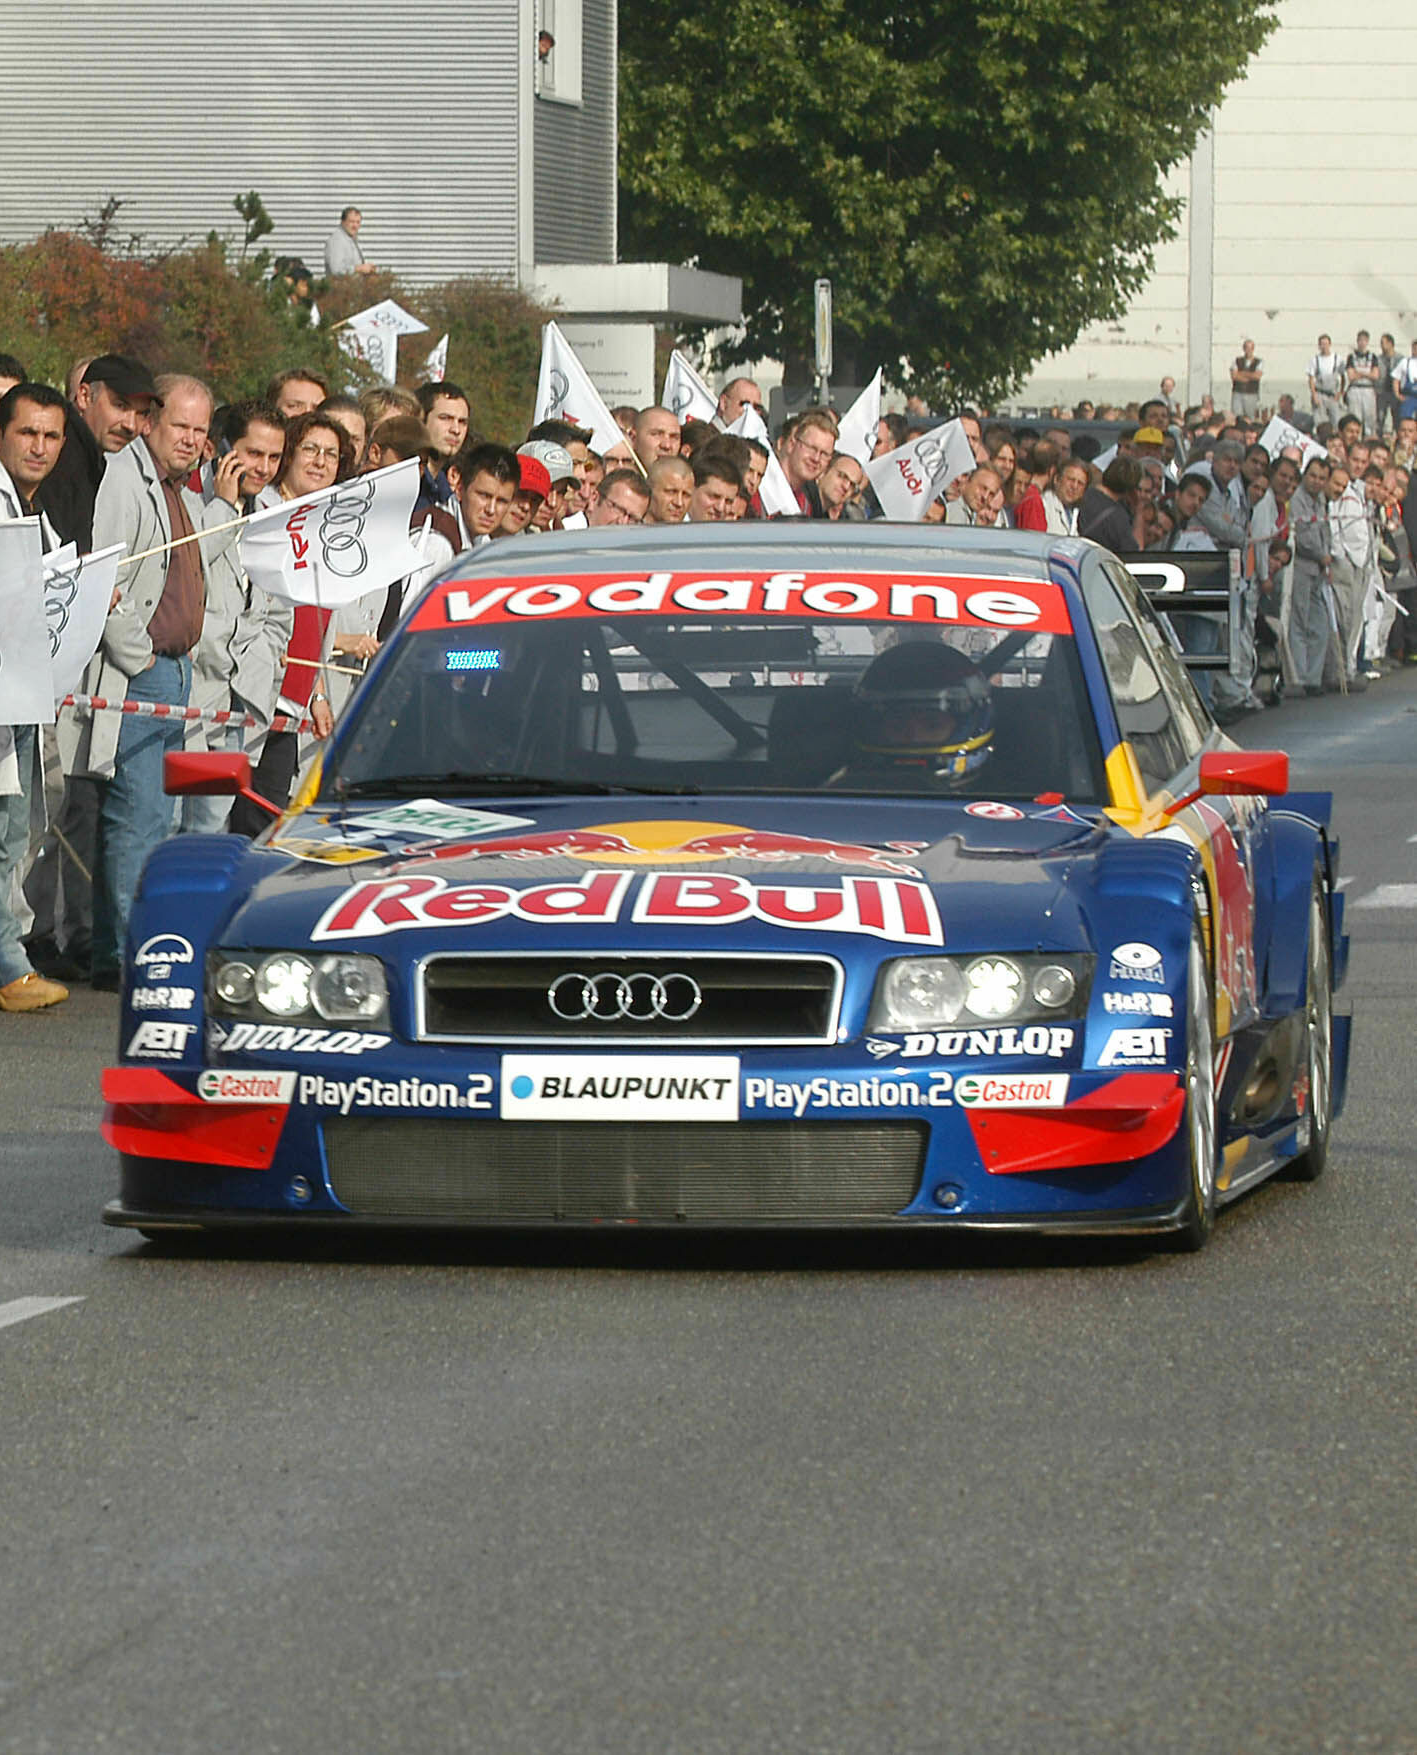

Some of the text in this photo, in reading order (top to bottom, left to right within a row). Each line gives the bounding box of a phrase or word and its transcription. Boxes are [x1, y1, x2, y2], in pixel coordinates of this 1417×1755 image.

[896, 459, 923, 496] Audi
[445, 573, 1042, 625] vodafone
[314, 872, 943, 945] Red Bull
[126, 1021, 190, 1057] ABT
[222, 1024, 392, 1054] DUNLOP
[900, 1027, 1074, 1057] DUNLOP
[1097, 1029, 1167, 1066] ABT
[220, 1075, 283, 1097] Castrol
[540, 1076, 730, 1102] BLAUPUNKT
[982, 1080, 1052, 1102] Castrol
